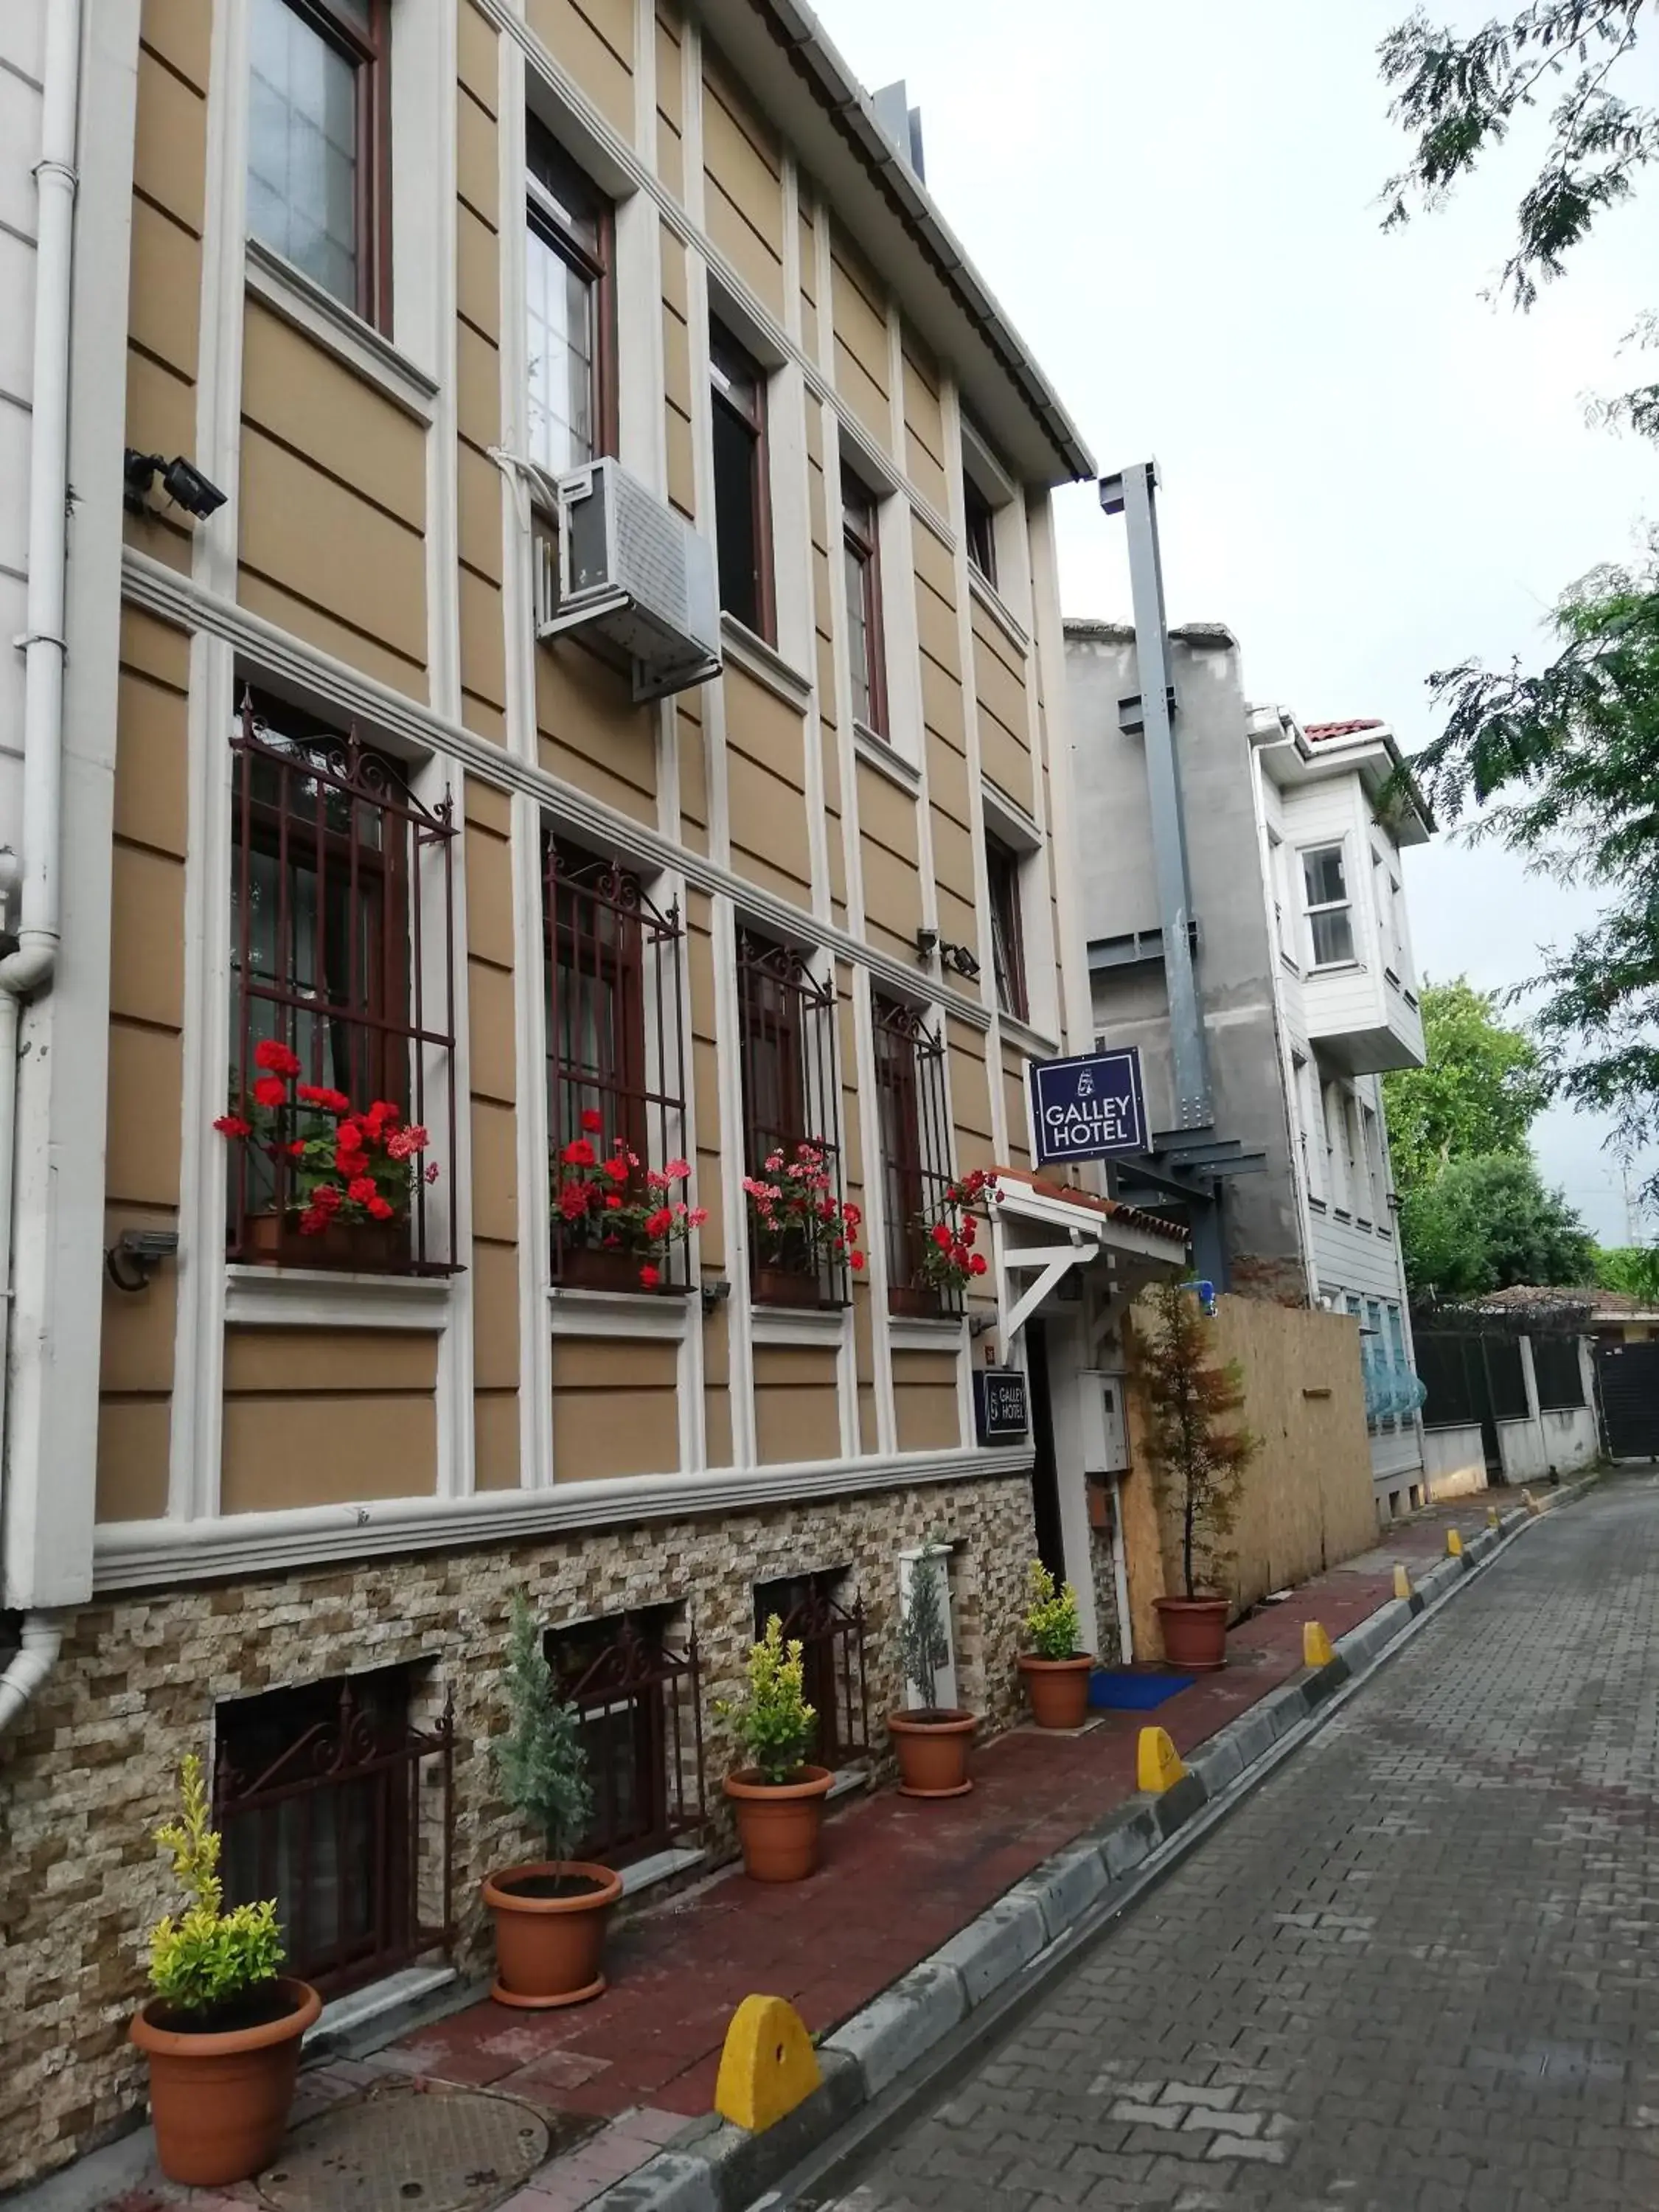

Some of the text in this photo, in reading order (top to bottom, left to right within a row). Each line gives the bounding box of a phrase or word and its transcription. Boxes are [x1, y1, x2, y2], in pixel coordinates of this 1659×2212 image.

[1046, 1095, 1130, 1125] GALLEY
[1054, 1119, 1127, 1147] HOTEL
[1002, 1403, 1023, 1419] HOTEL
